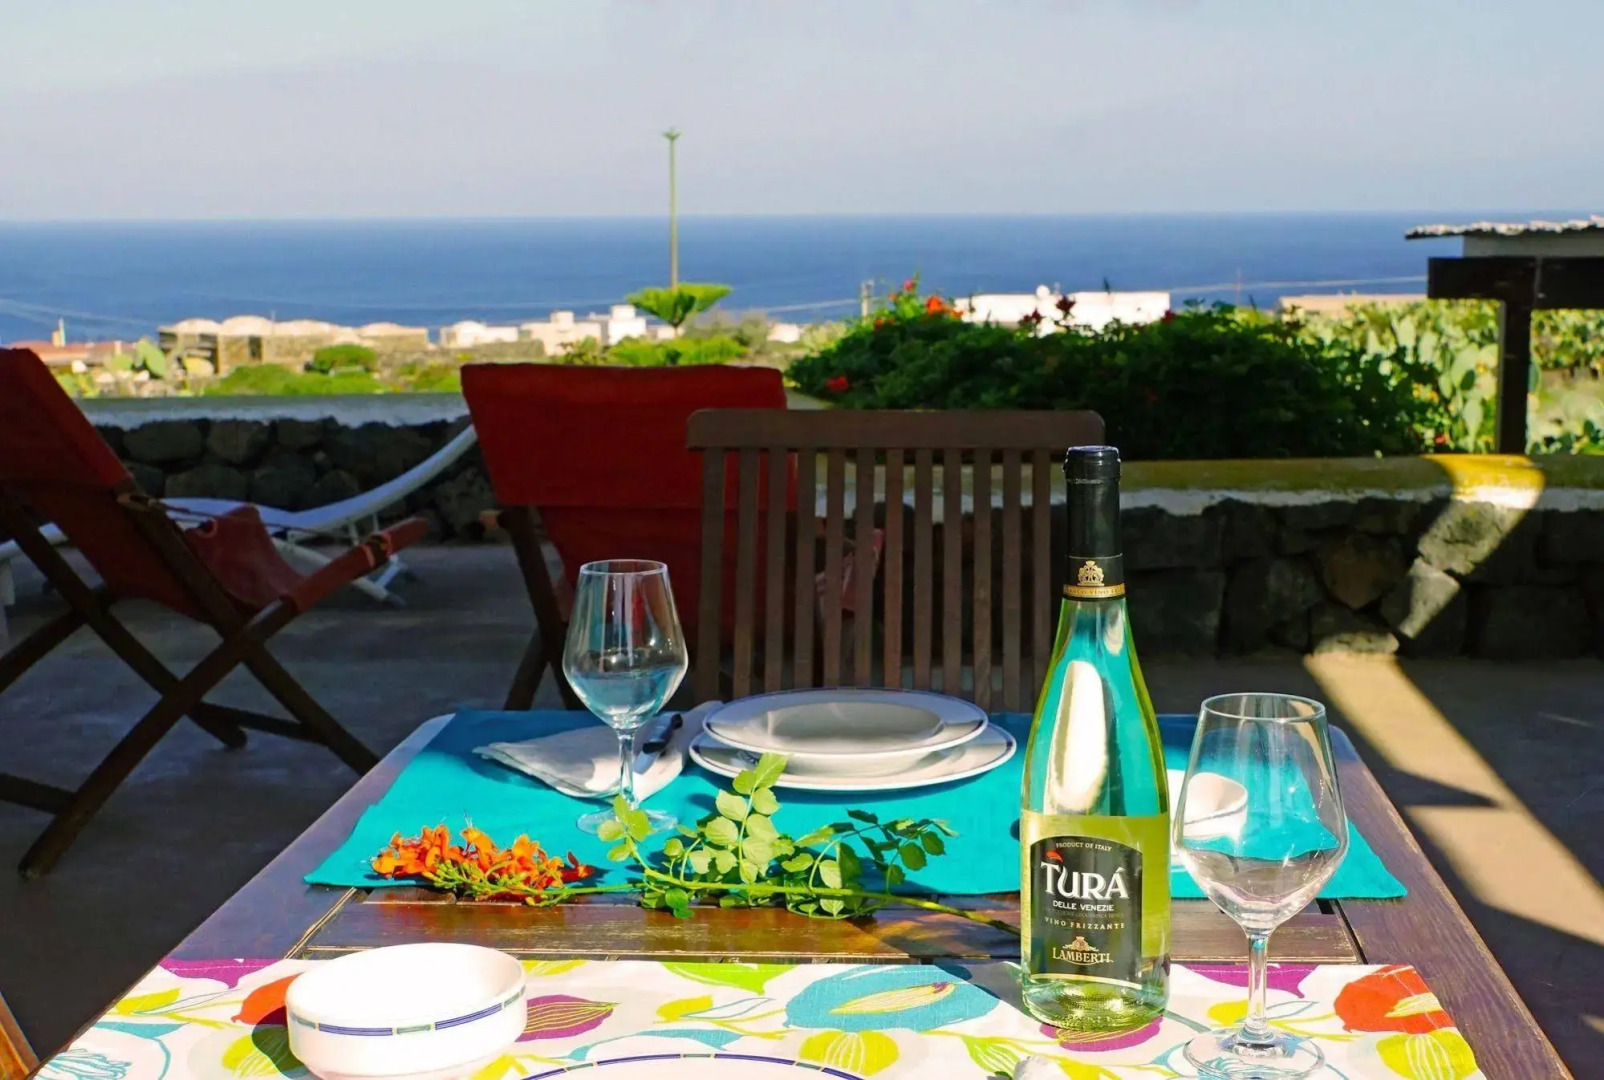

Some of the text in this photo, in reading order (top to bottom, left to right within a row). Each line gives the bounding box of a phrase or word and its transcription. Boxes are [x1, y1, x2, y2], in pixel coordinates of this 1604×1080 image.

[1052, 900, 1114, 912] DELLE VENEZIE
[1044, 916, 1126, 930] VINO FRIZZANTE
[1052, 947, 1112, 964] LAMBERTI
